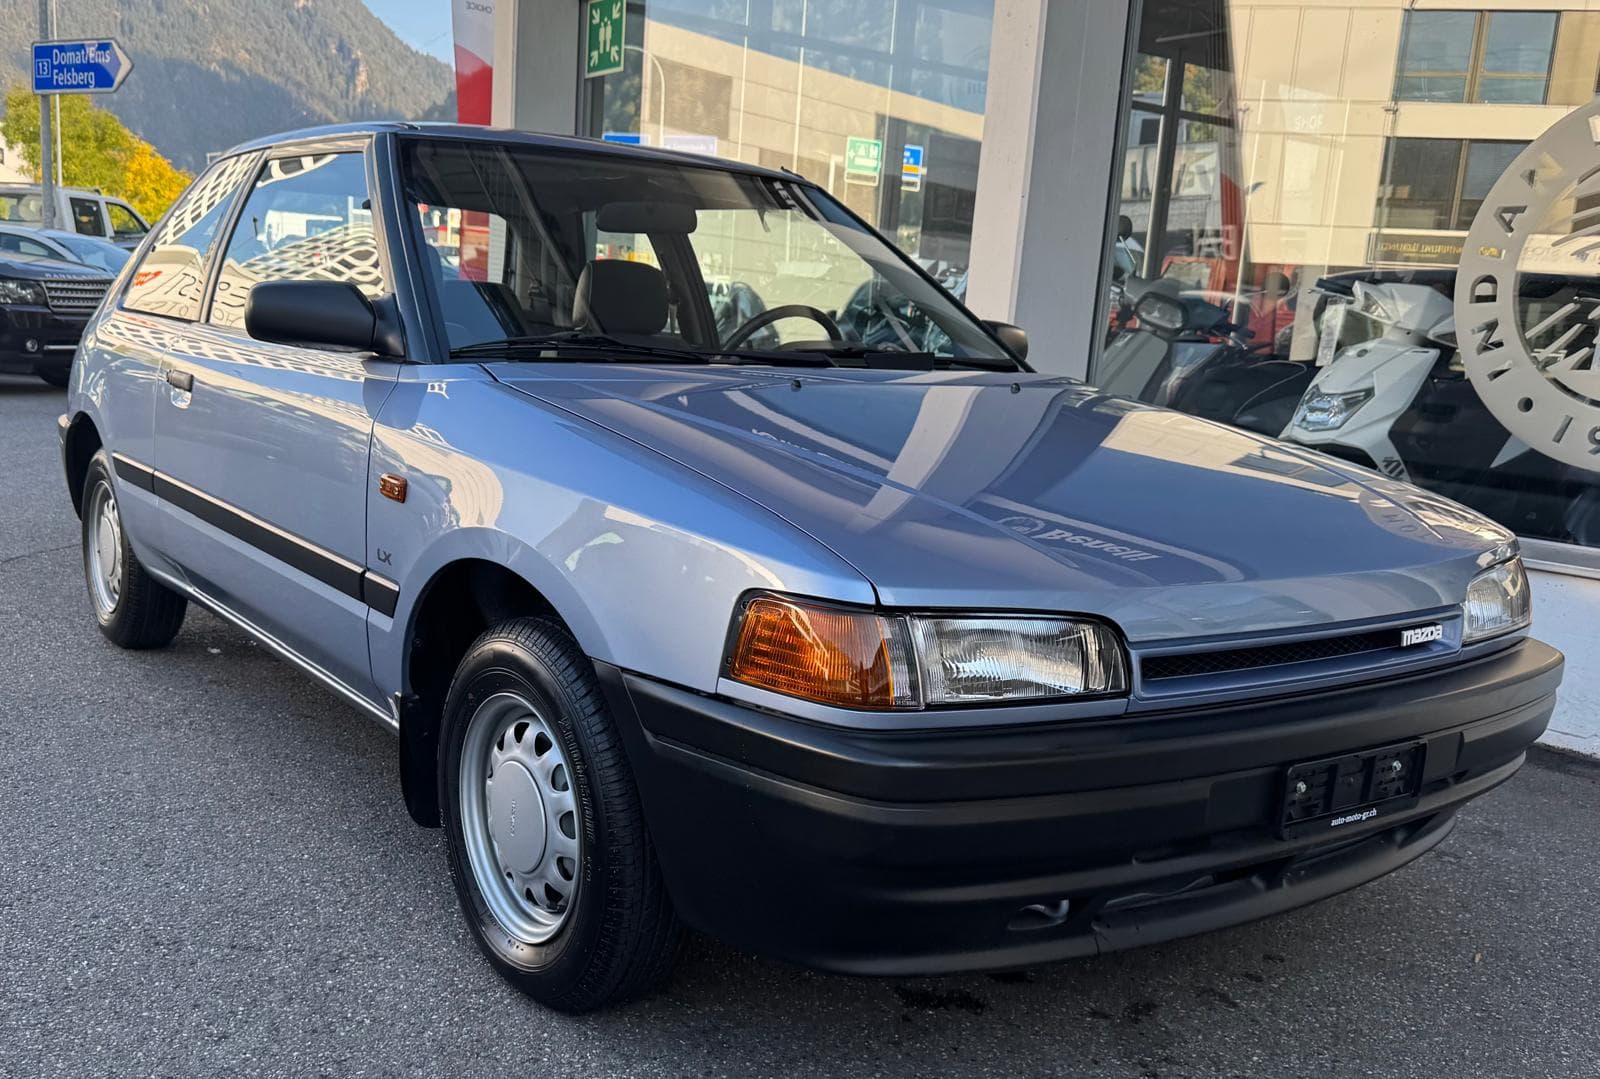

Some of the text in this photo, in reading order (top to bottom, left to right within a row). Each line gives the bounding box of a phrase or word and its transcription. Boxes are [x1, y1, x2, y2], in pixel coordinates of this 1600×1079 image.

[52, 47, 111, 65] Domat/Ems
[38, 61, 48, 75] 13
[53, 68, 95, 88] Felsberg
[377, 548, 392, 566] LX
[1401, 625, 1442, 647] mazda
[1330, 807, 1377, 827] auto-moto-gr.ch
